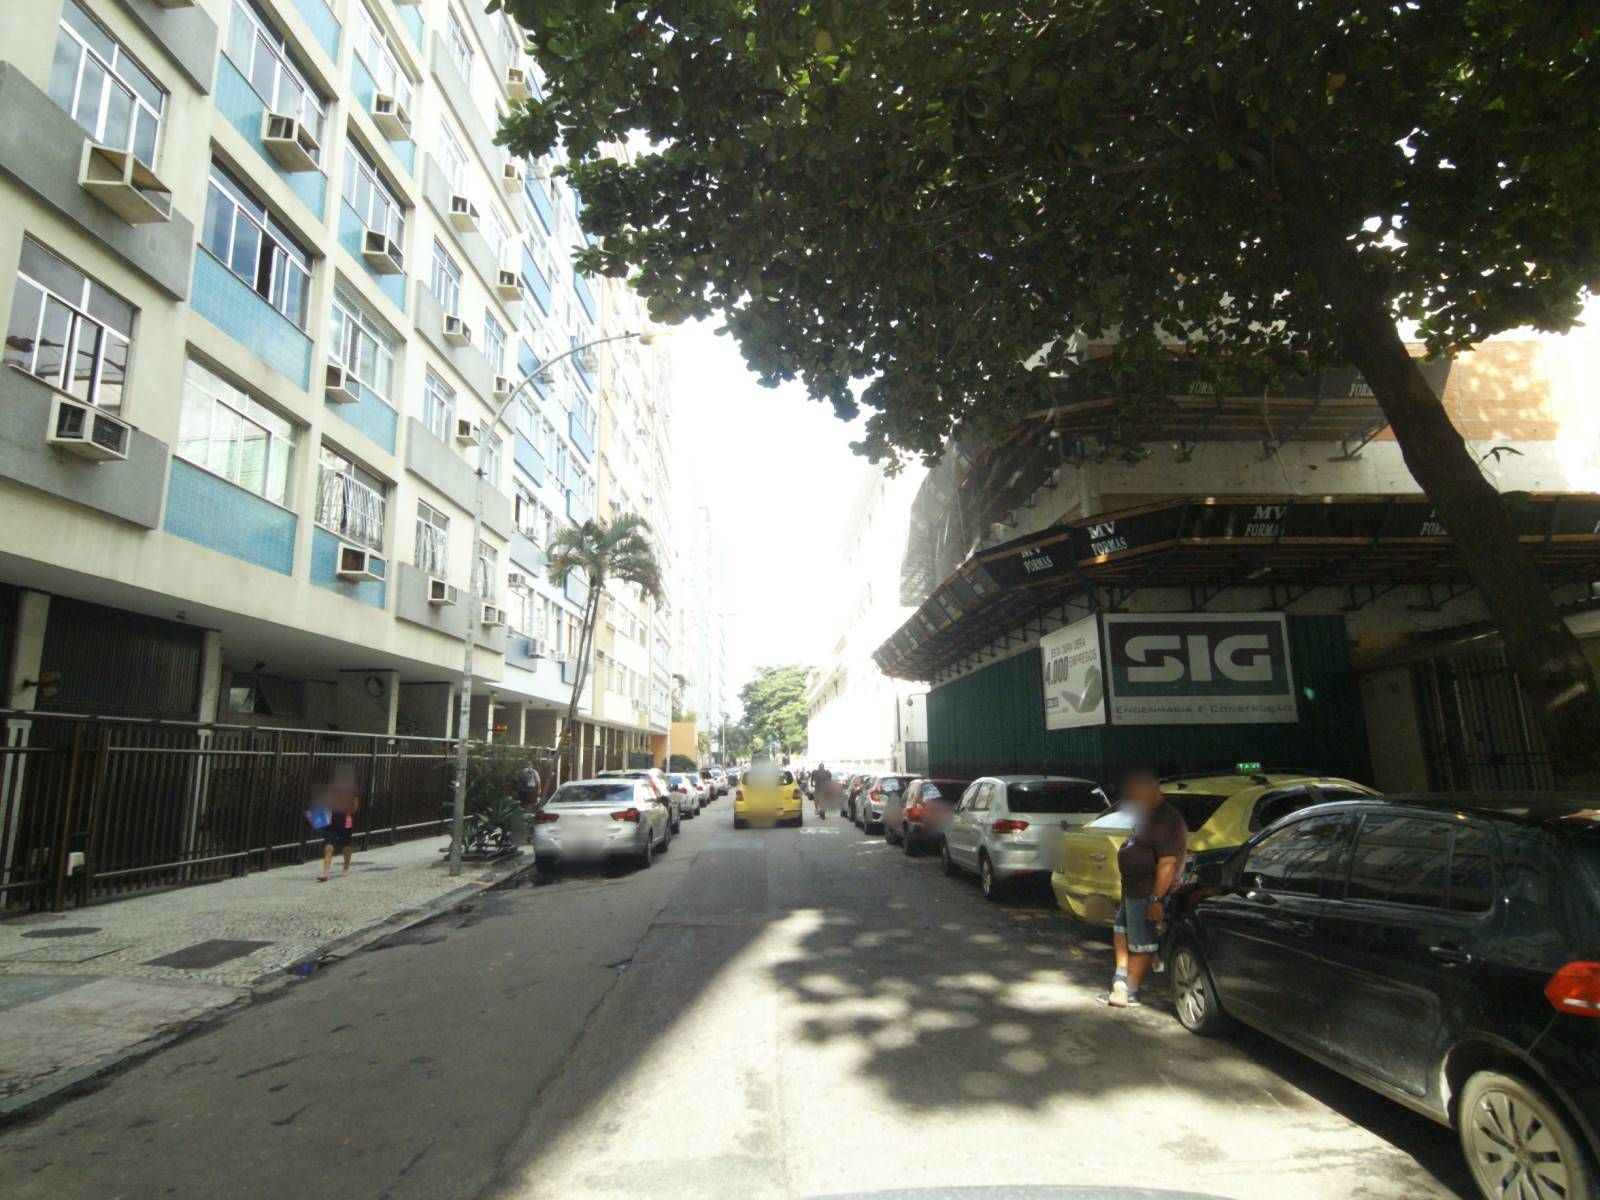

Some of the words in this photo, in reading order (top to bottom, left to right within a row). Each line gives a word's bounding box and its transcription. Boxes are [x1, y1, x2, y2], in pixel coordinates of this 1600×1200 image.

[1252, 505, 1287, 519] MV
[1088, 521, 1115, 539] MV
[1091, 536, 1128, 556] FORMAS
[1124, 635, 1273, 682] SIG
